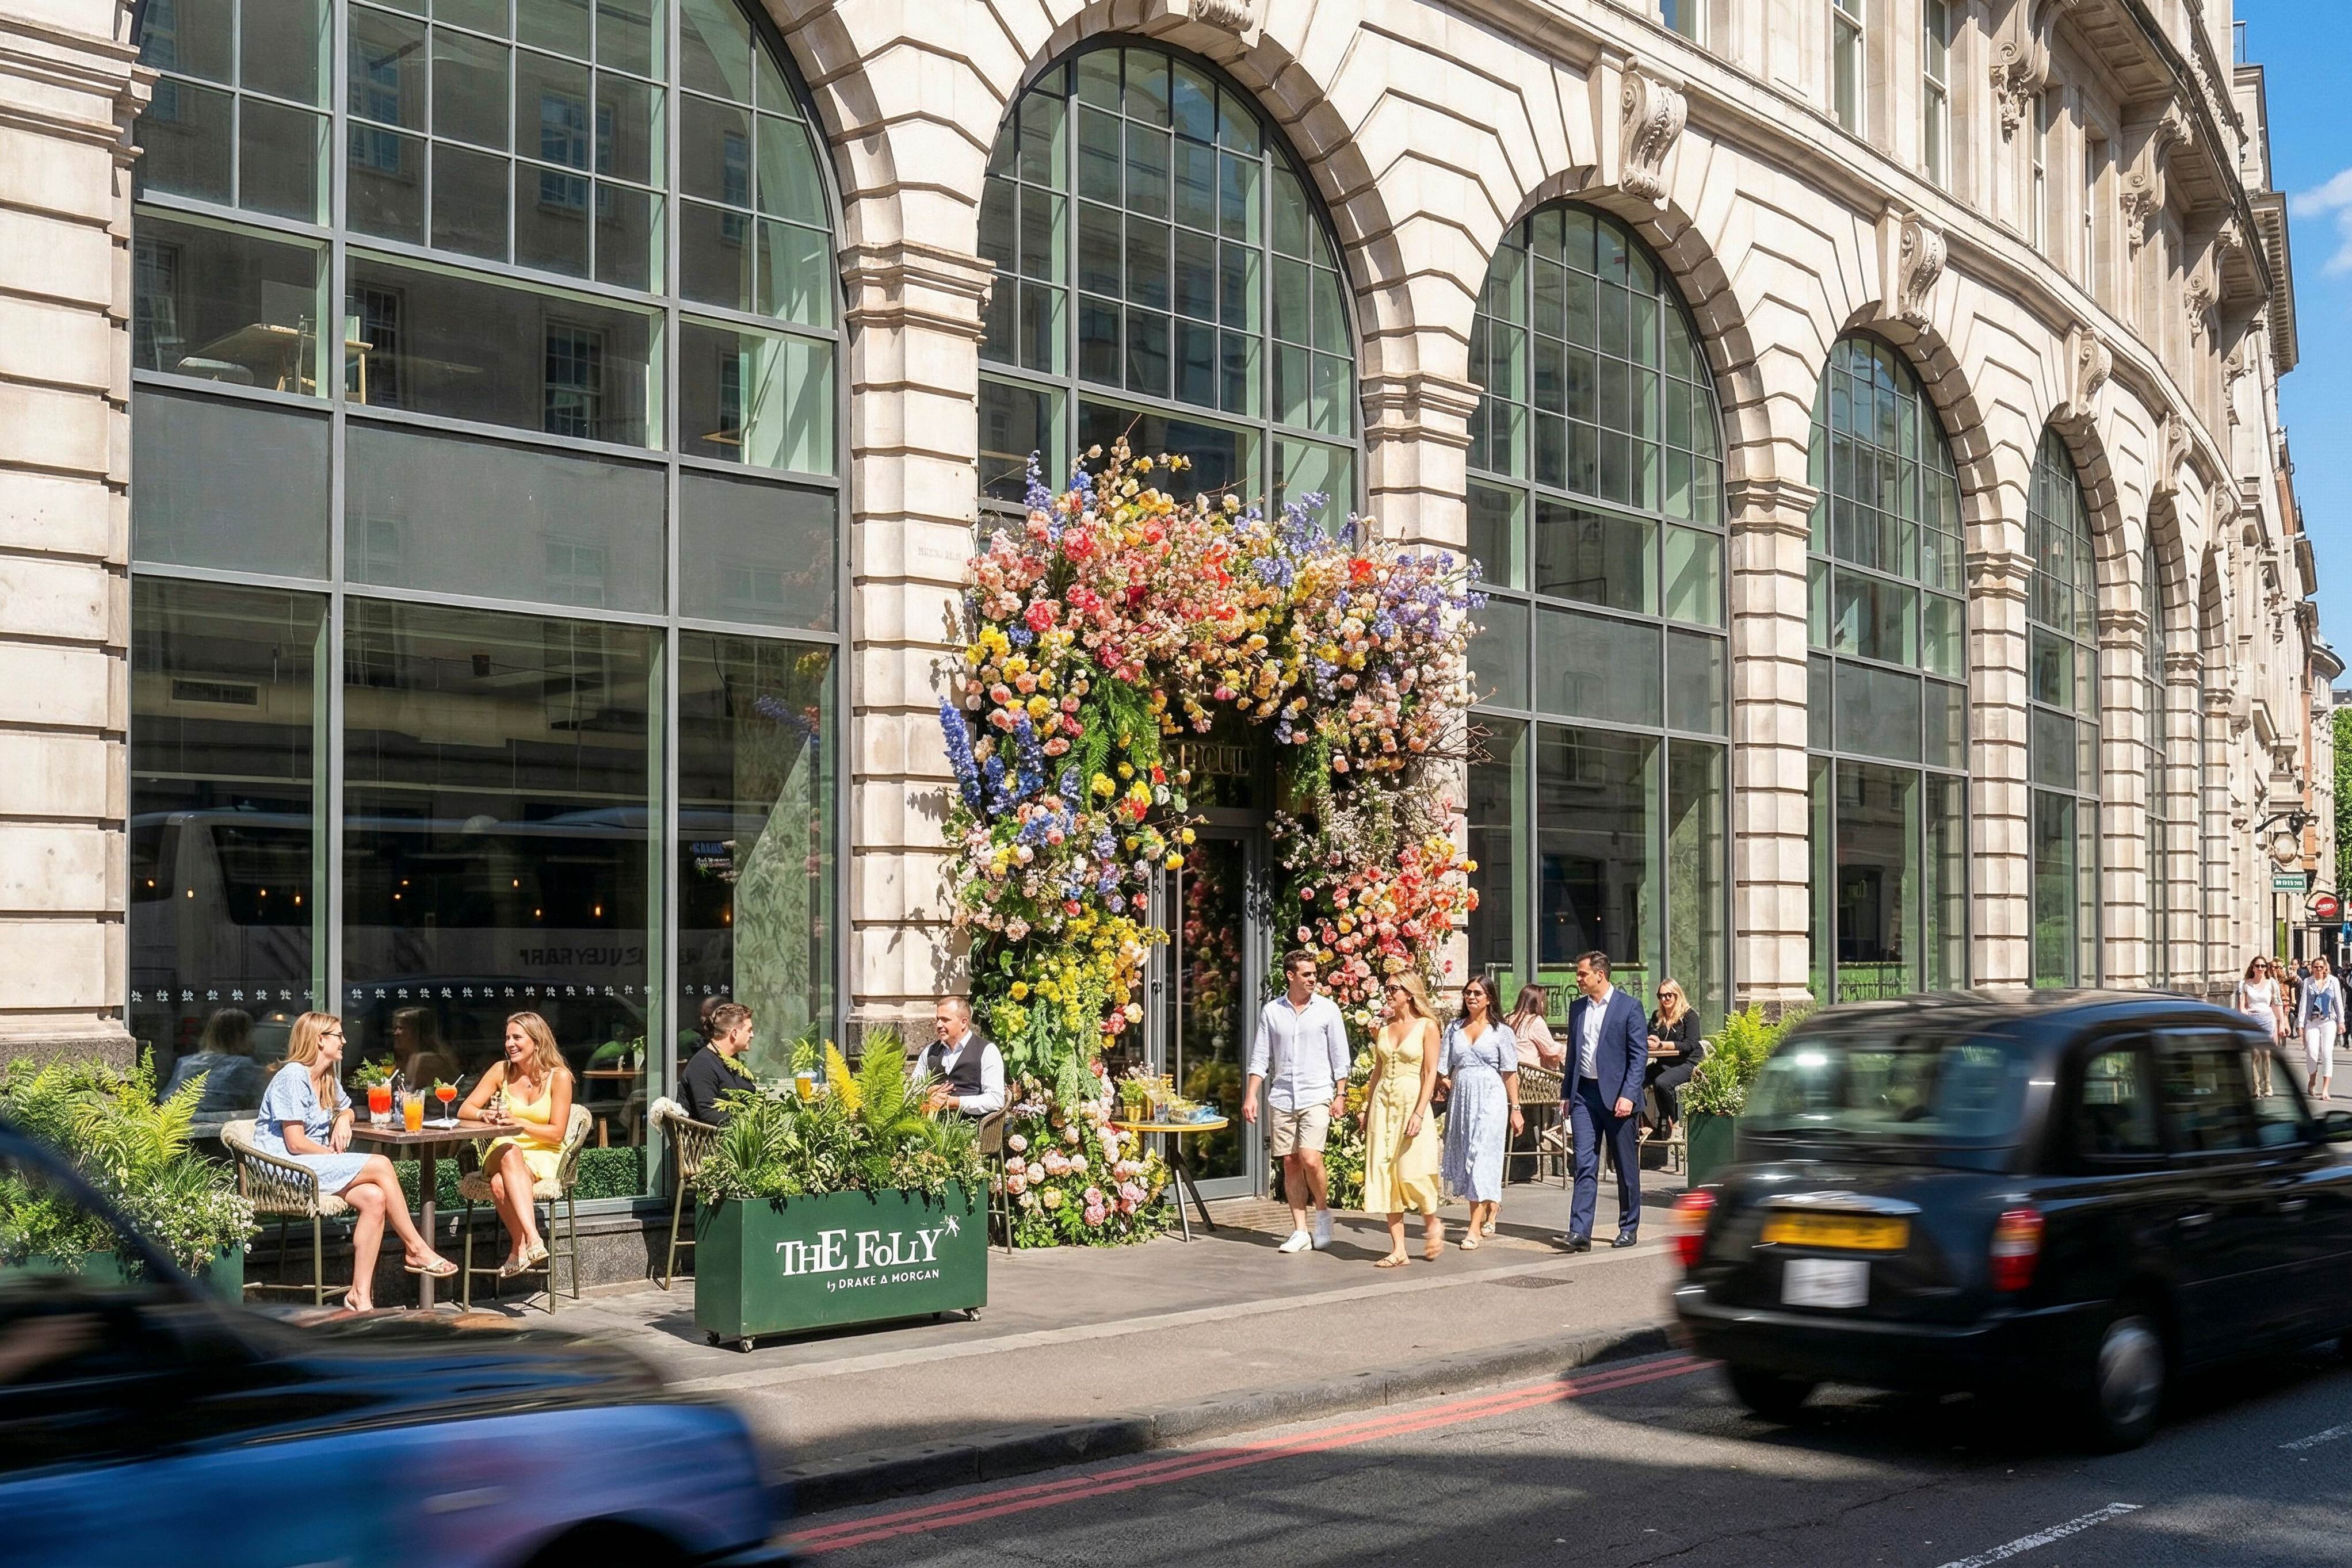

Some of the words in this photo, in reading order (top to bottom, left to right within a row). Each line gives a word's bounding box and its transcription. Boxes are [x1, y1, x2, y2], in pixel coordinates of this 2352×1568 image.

[776, 1229, 847, 1276] THE
[839, 1275, 876, 1290] DRAKE
[892, 1268, 940, 1283] MORGAN
